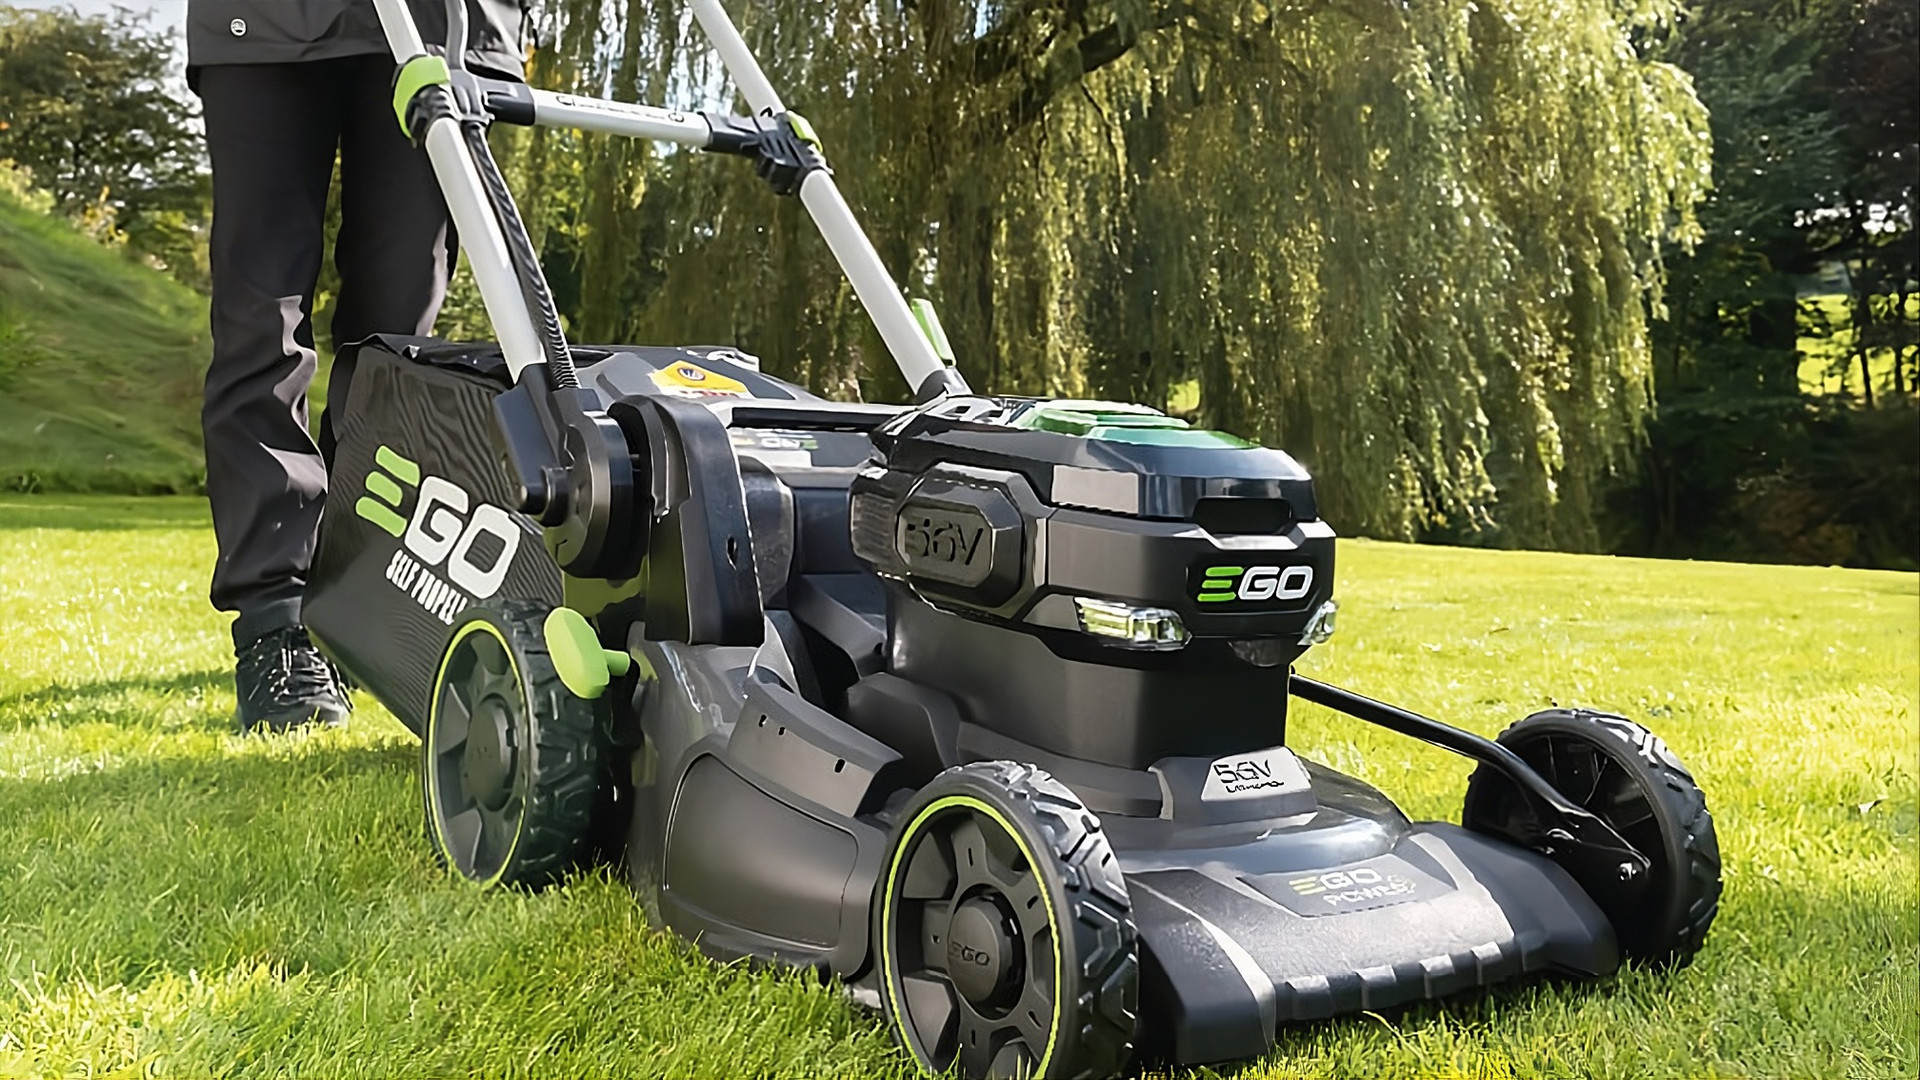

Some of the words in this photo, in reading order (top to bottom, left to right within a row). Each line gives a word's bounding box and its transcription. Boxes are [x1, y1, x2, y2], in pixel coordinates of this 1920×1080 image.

[355, 445, 521, 599] EGO
[907, 518, 984, 566] 56V
[386, 549, 421, 592] SELF
[1197, 565, 1314, 602] EGO
[1213, 759, 1272, 784] 56V
[1288, 868, 1382, 896] EGO
